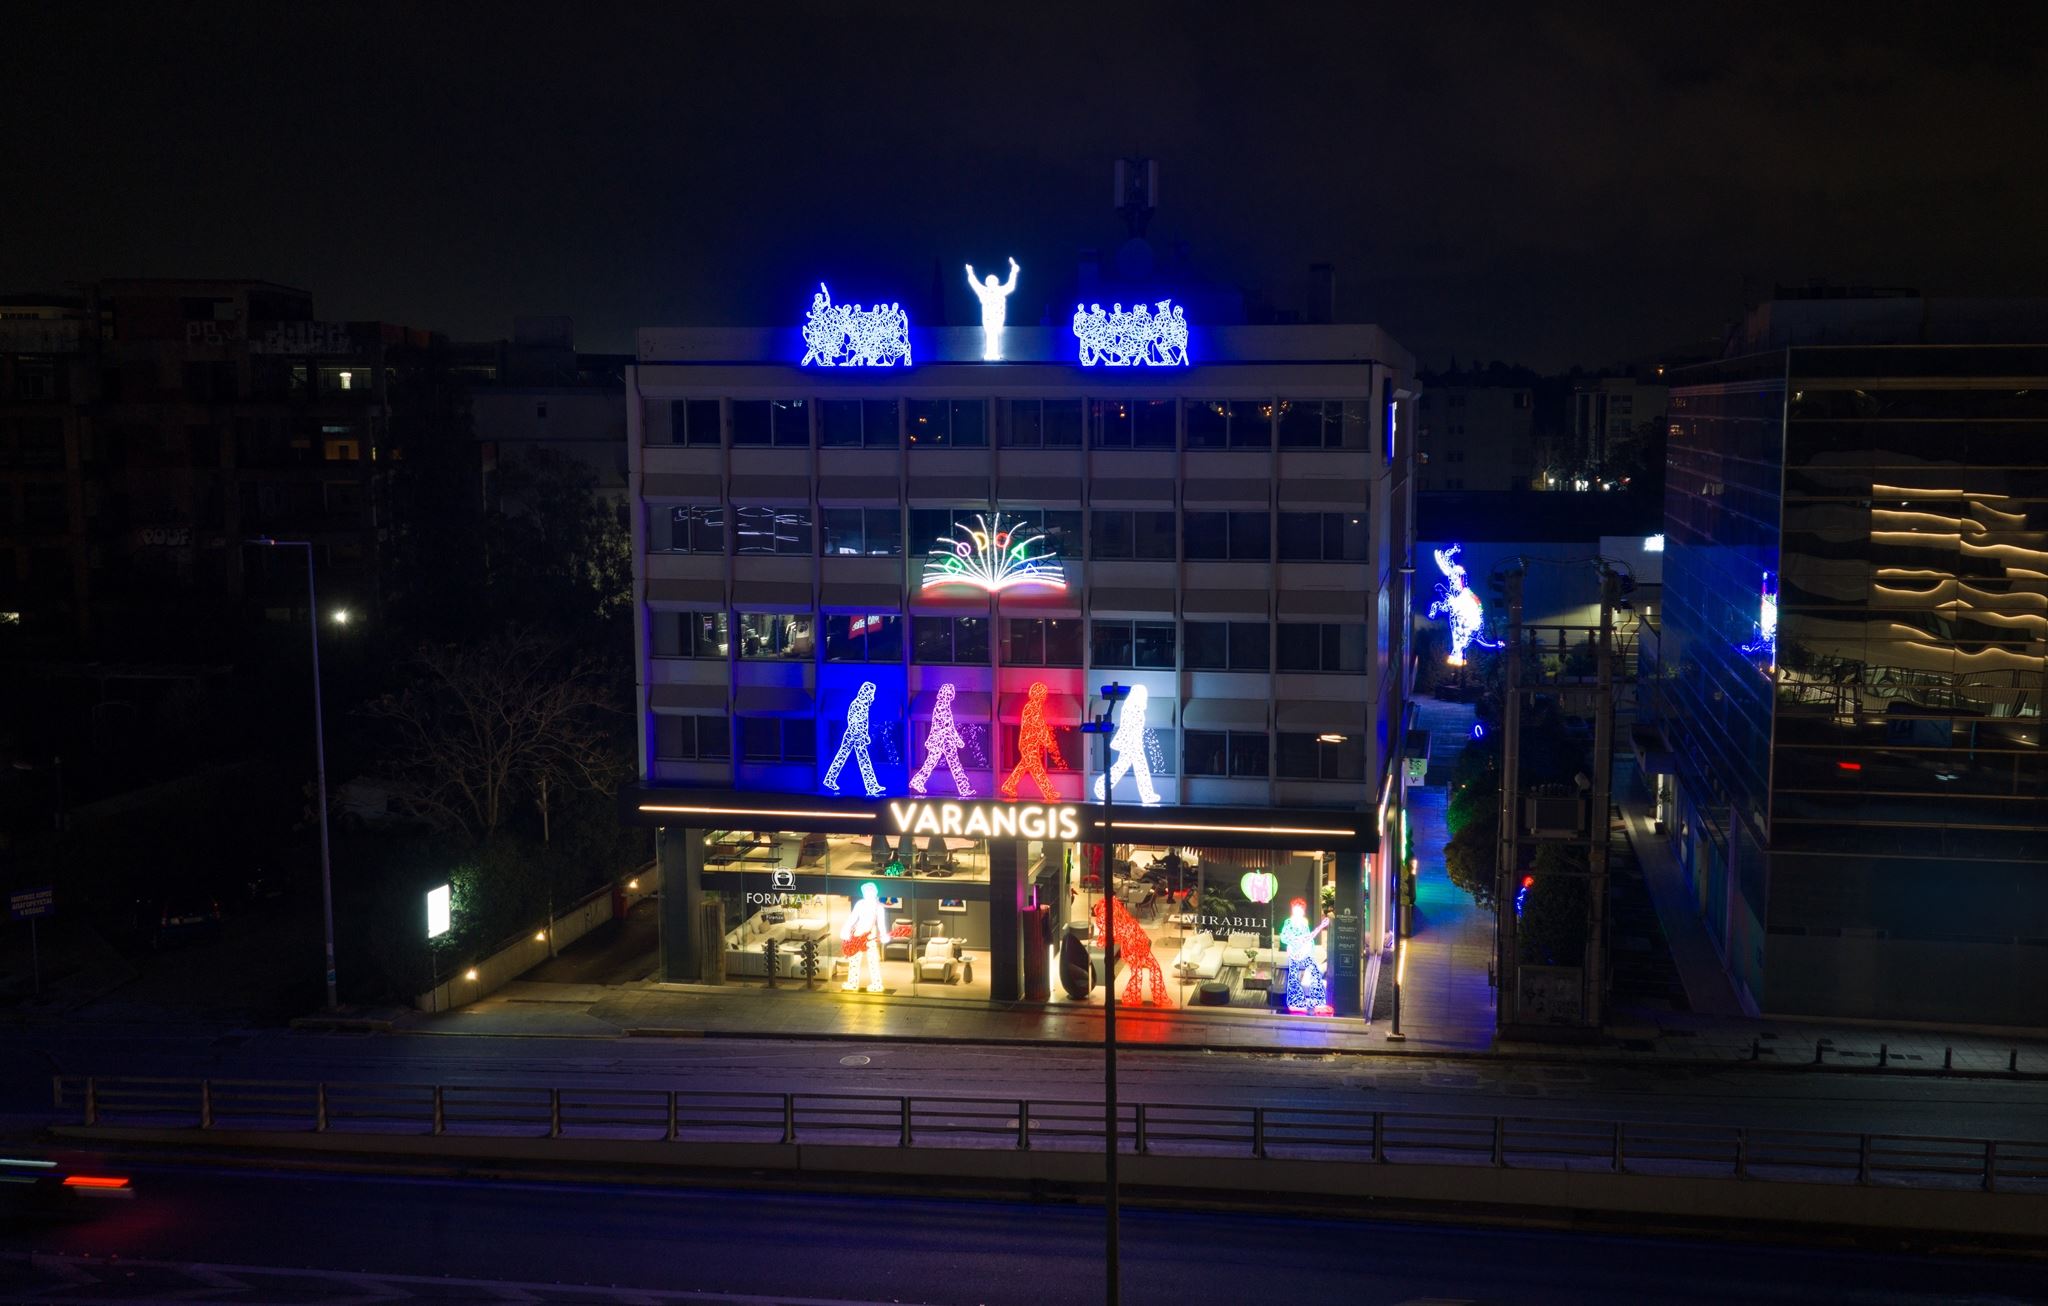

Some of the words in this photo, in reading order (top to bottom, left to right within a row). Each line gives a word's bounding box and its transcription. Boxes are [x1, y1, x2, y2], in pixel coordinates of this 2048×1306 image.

[889, 801, 1080, 840] VARANGIS
[746, 892, 824, 907] FORMITALIA
[1183, 915, 1268, 929] MIRABILI
